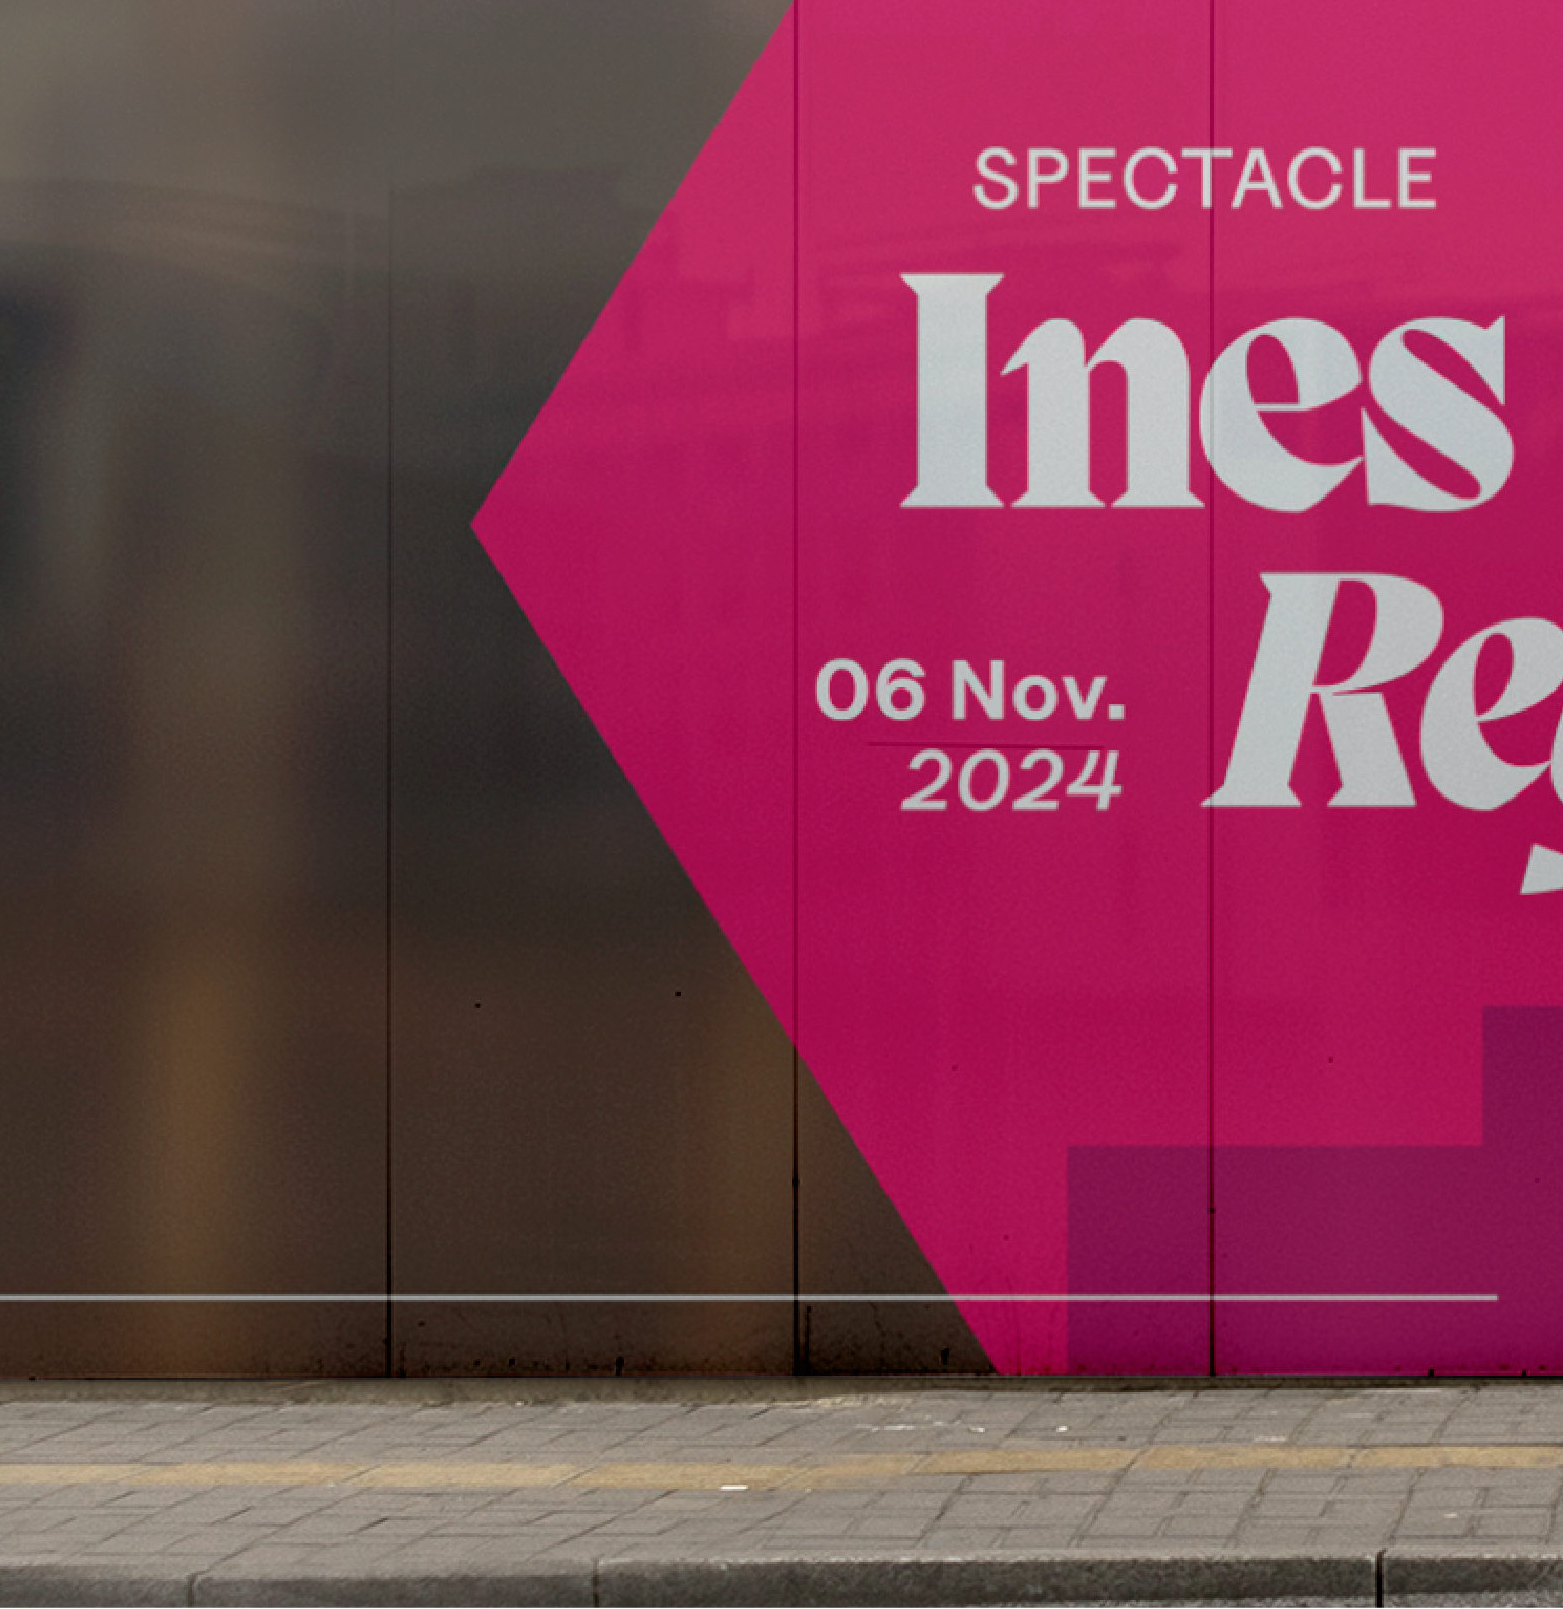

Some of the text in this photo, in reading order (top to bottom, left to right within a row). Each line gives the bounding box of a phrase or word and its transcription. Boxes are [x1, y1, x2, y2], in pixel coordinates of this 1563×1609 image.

[973, 147, 1438, 210] SPECTACLE
[900, 273, 1515, 512] Ines
[816, 657, 1126, 720] 06 Nov.
[900, 748, 1122, 812] 2024
